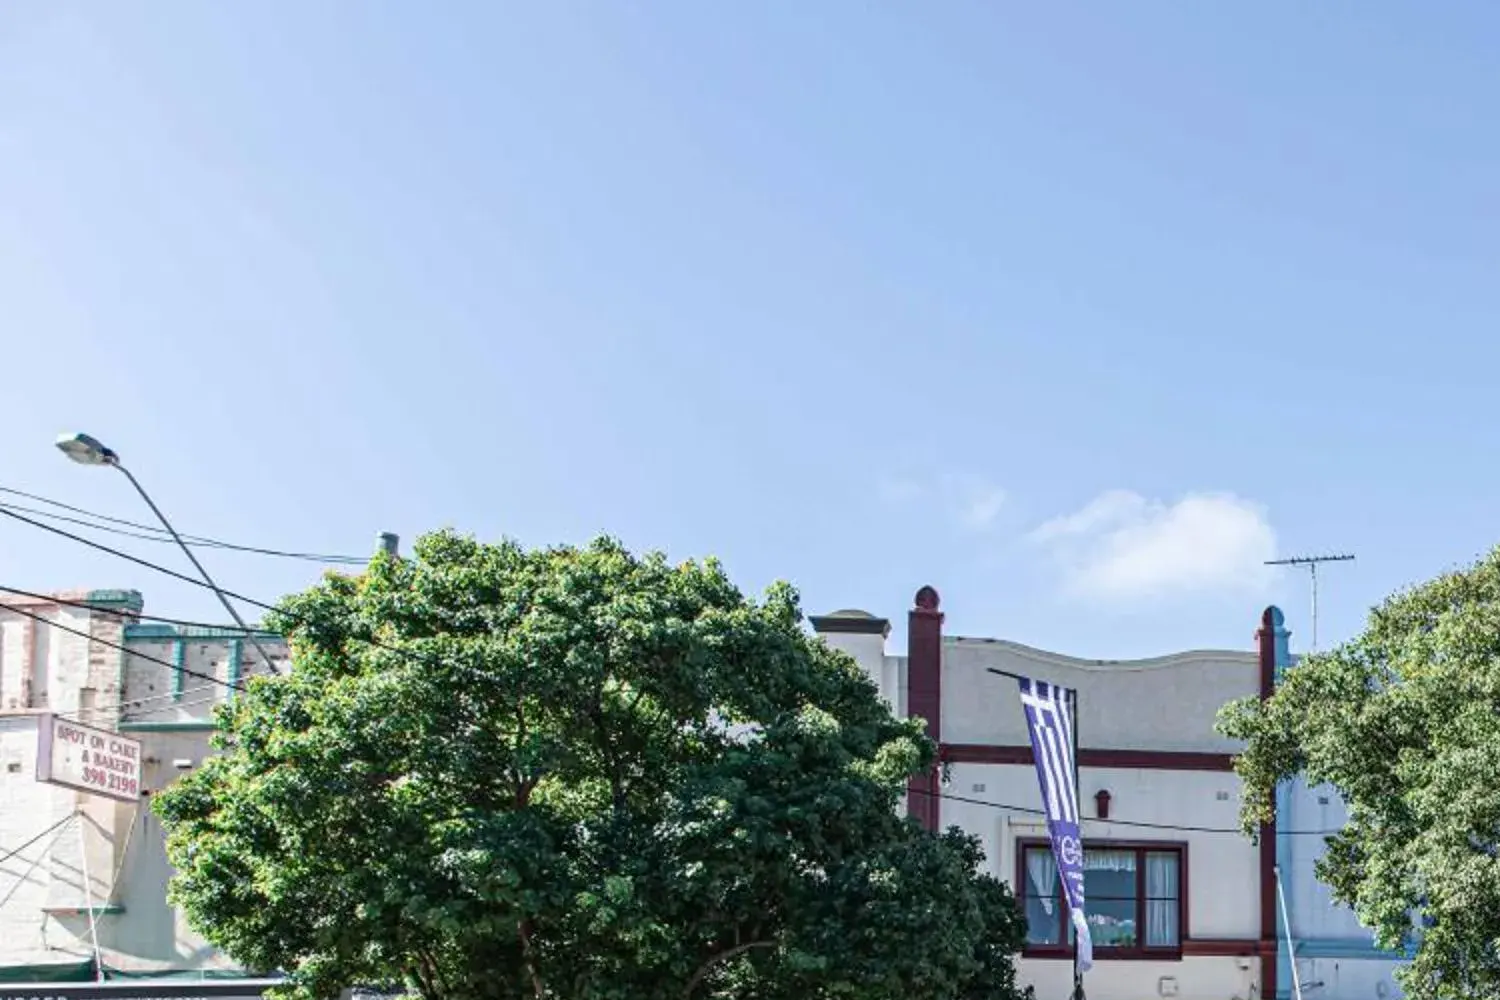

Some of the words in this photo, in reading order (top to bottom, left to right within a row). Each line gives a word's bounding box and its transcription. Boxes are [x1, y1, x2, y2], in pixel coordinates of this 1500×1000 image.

[58, 725, 86, 745] SPOT
[91, 736, 105, 749] ON
[110, 741, 139, 759] CAKE
[82, 767, 106, 785] 398
[94, 752, 135, 776] BAKERY
